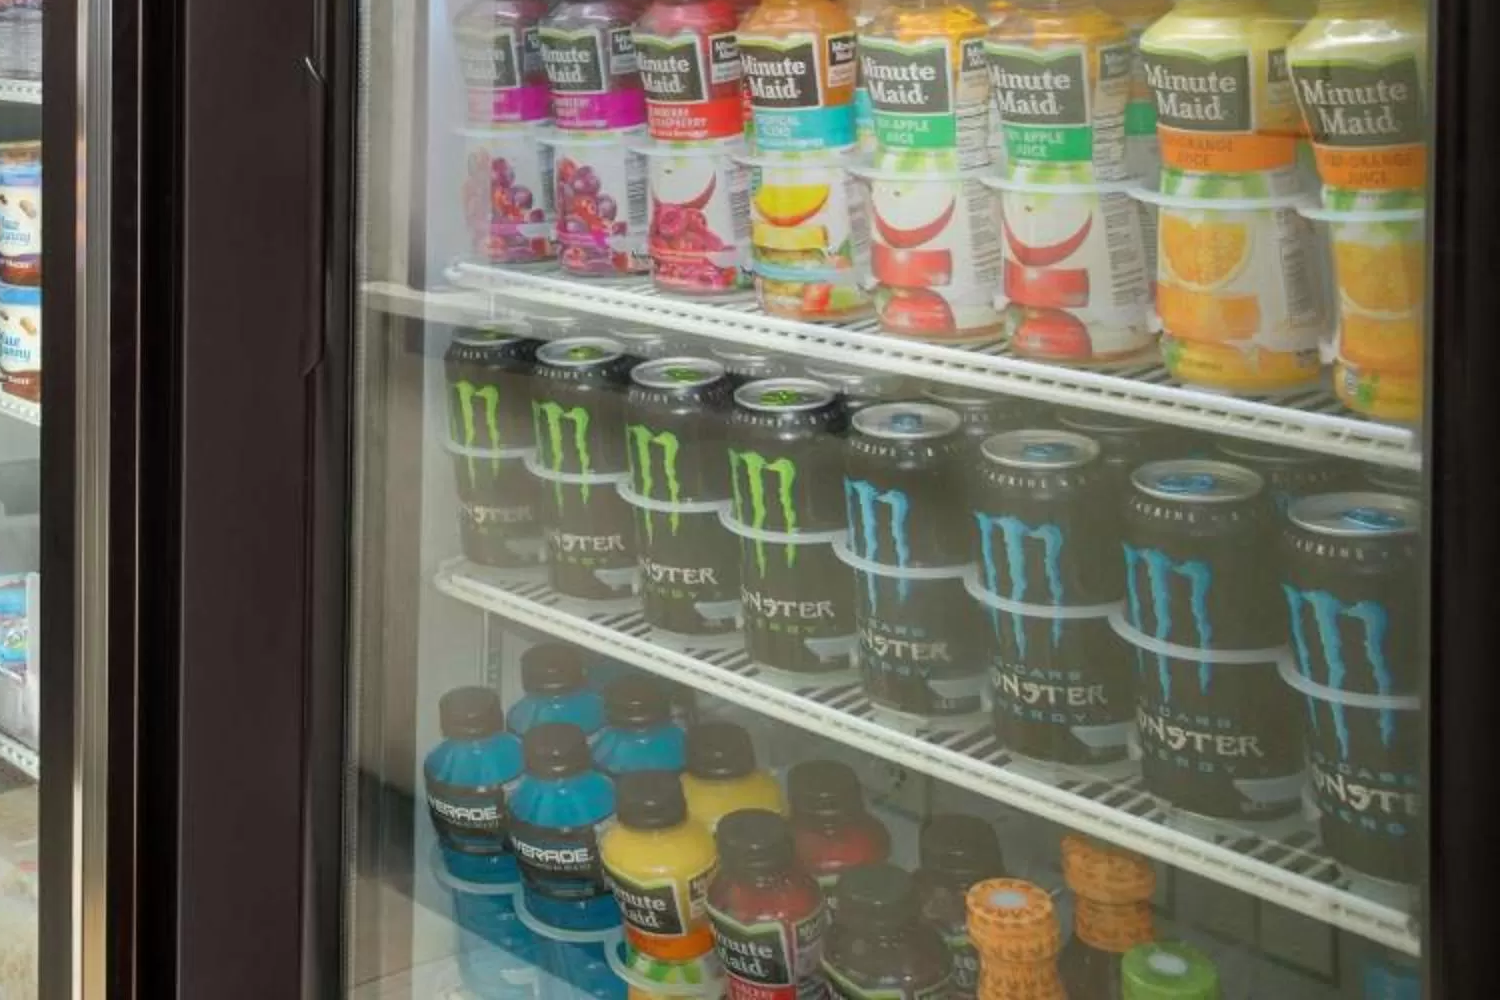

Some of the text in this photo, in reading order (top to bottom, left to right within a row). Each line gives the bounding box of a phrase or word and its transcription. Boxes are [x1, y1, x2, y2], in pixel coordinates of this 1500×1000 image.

[860, 55, 936, 82] Minute
[988, 63, 1071, 90] Minute
[1144, 62, 1237, 93] Minute
[749, 75, 799, 99] Maid
[867, 79, 925, 105] Maid
[1300, 78, 1409, 106] Minute
[996, 88, 1060, 116] Maid
[1156, 91, 1223, 121] Maid
[1318, 106, 1394, 136] Maid
[1024, 130, 1064, 144] APPLE
[639, 555, 719, 585] NSTER
[740, 584, 836, 618] NSTER
[860, 626, 953, 662] NSTER
[612, 885, 667, 912] nute
[622, 908, 660, 929] aid
[717, 932, 773, 959] nute
[721, 952, 765, 977] aid
